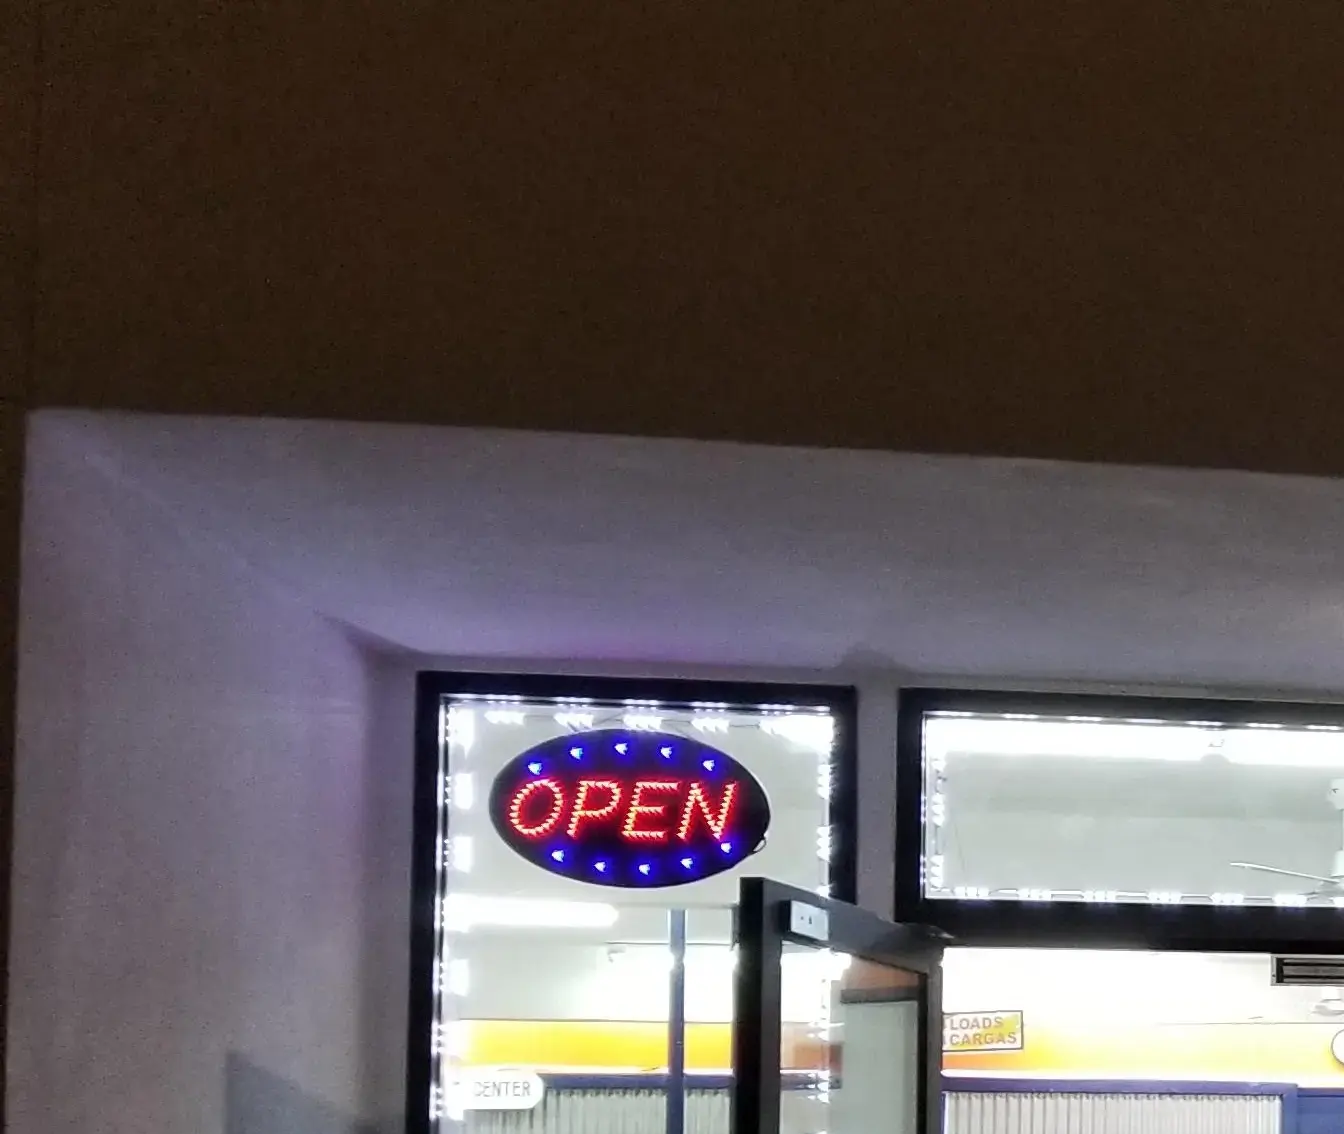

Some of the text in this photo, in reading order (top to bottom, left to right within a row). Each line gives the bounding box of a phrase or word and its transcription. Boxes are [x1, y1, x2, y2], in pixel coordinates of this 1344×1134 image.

[507, 778, 739, 841] OPEN
[950, 1015, 1004, 1031] LOADS
[949, 1031, 1018, 1047] CARGAS
